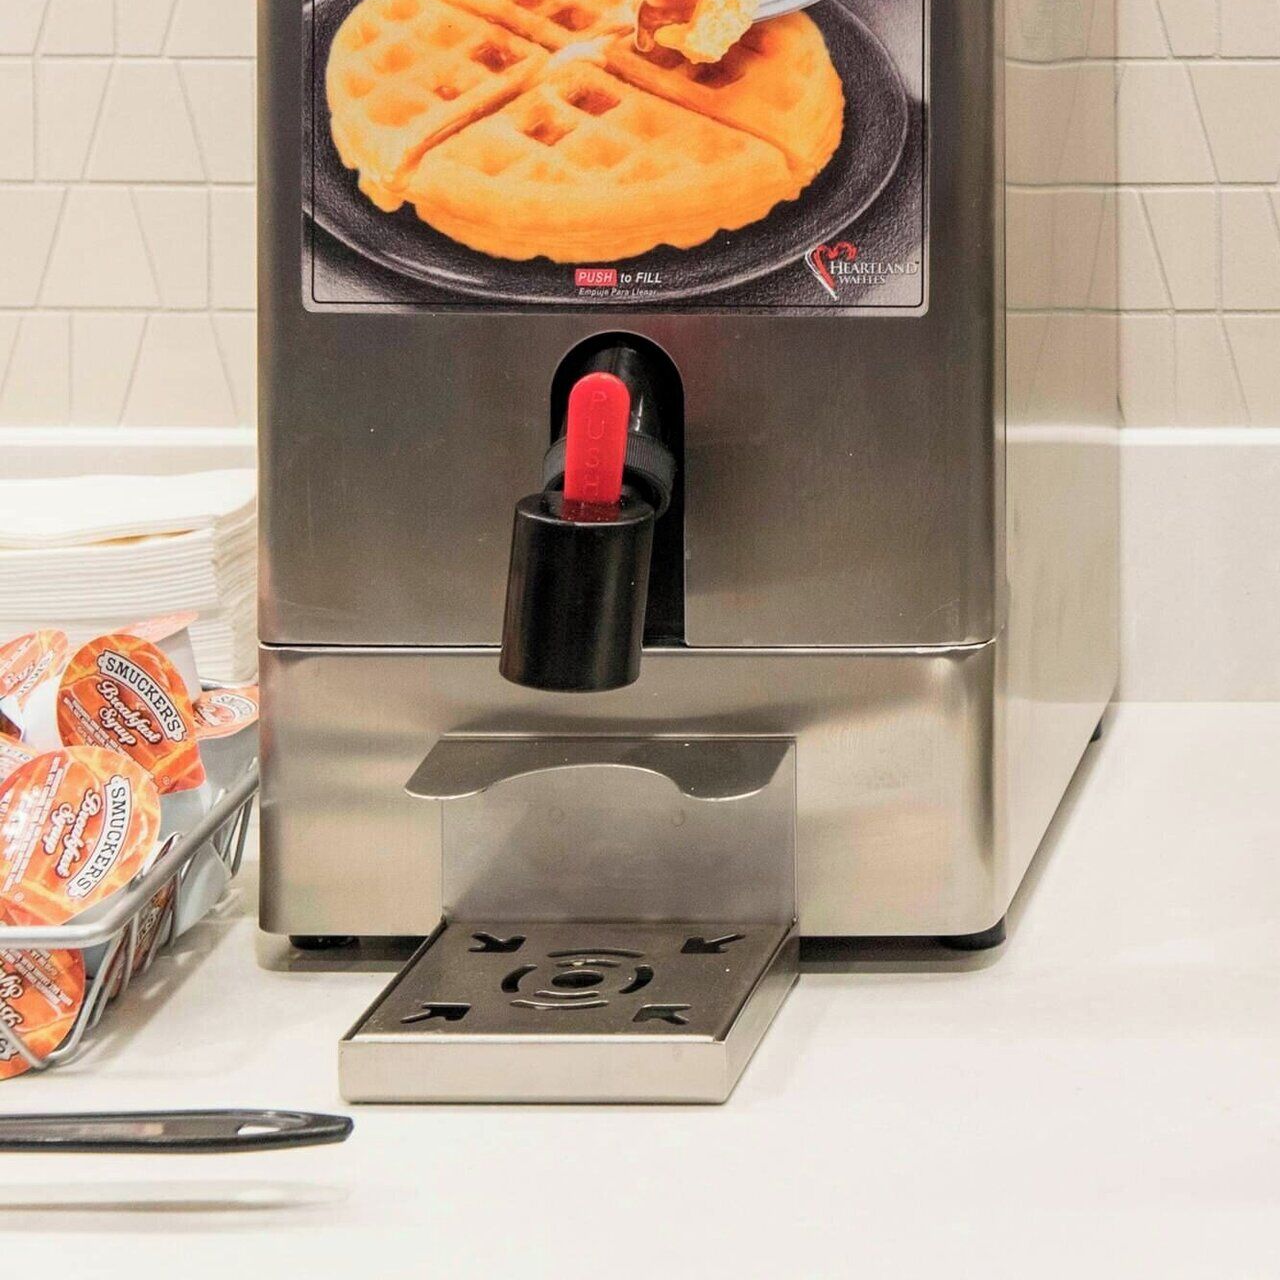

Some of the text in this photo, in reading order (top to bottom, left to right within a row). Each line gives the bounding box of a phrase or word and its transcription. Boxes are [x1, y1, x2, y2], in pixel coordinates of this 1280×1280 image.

[579, 271, 662, 283] PUSH to FILL
[831, 261, 918, 275] HEARTLAND
[839, 275, 886, 285] WAFFLES
[579, 287, 657, 297] Empuje Para Llenar
[97, 679, 163, 745] Breakfast
[104, 656, 182, 733] SMUCKER'S
[100, 706, 137, 746] Syrup
[42, 803, 76, 854] Syrup
[56, 787, 101, 878] Breakfast
